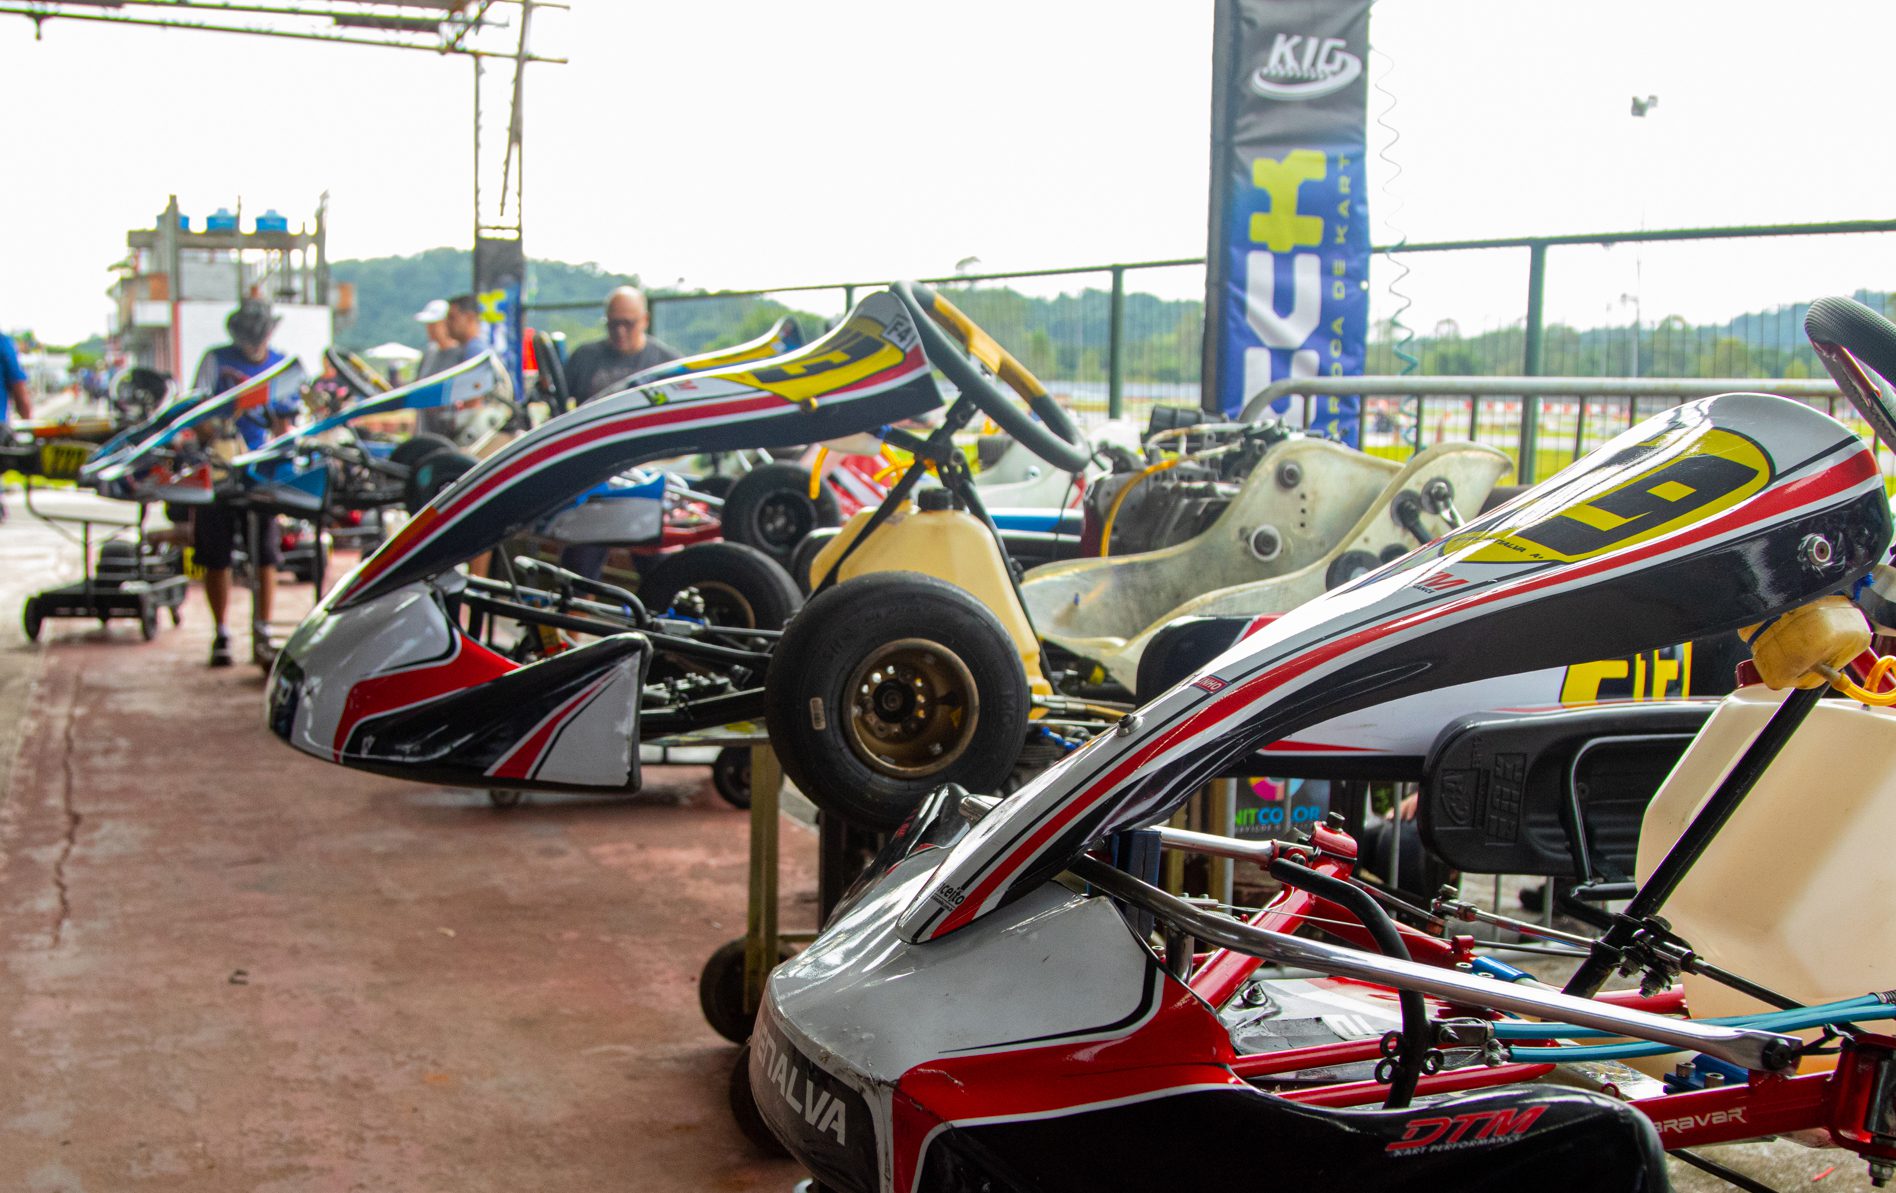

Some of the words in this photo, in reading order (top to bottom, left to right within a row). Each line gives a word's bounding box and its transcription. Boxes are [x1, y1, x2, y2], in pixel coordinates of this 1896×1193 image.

[1334, 153, 1352, 244] KART
[1332, 259, 1346, 300] DE
[1385, 1094, 1551, 1151] DTM
[1429, 1134, 1522, 1154] PERFORMANCE
